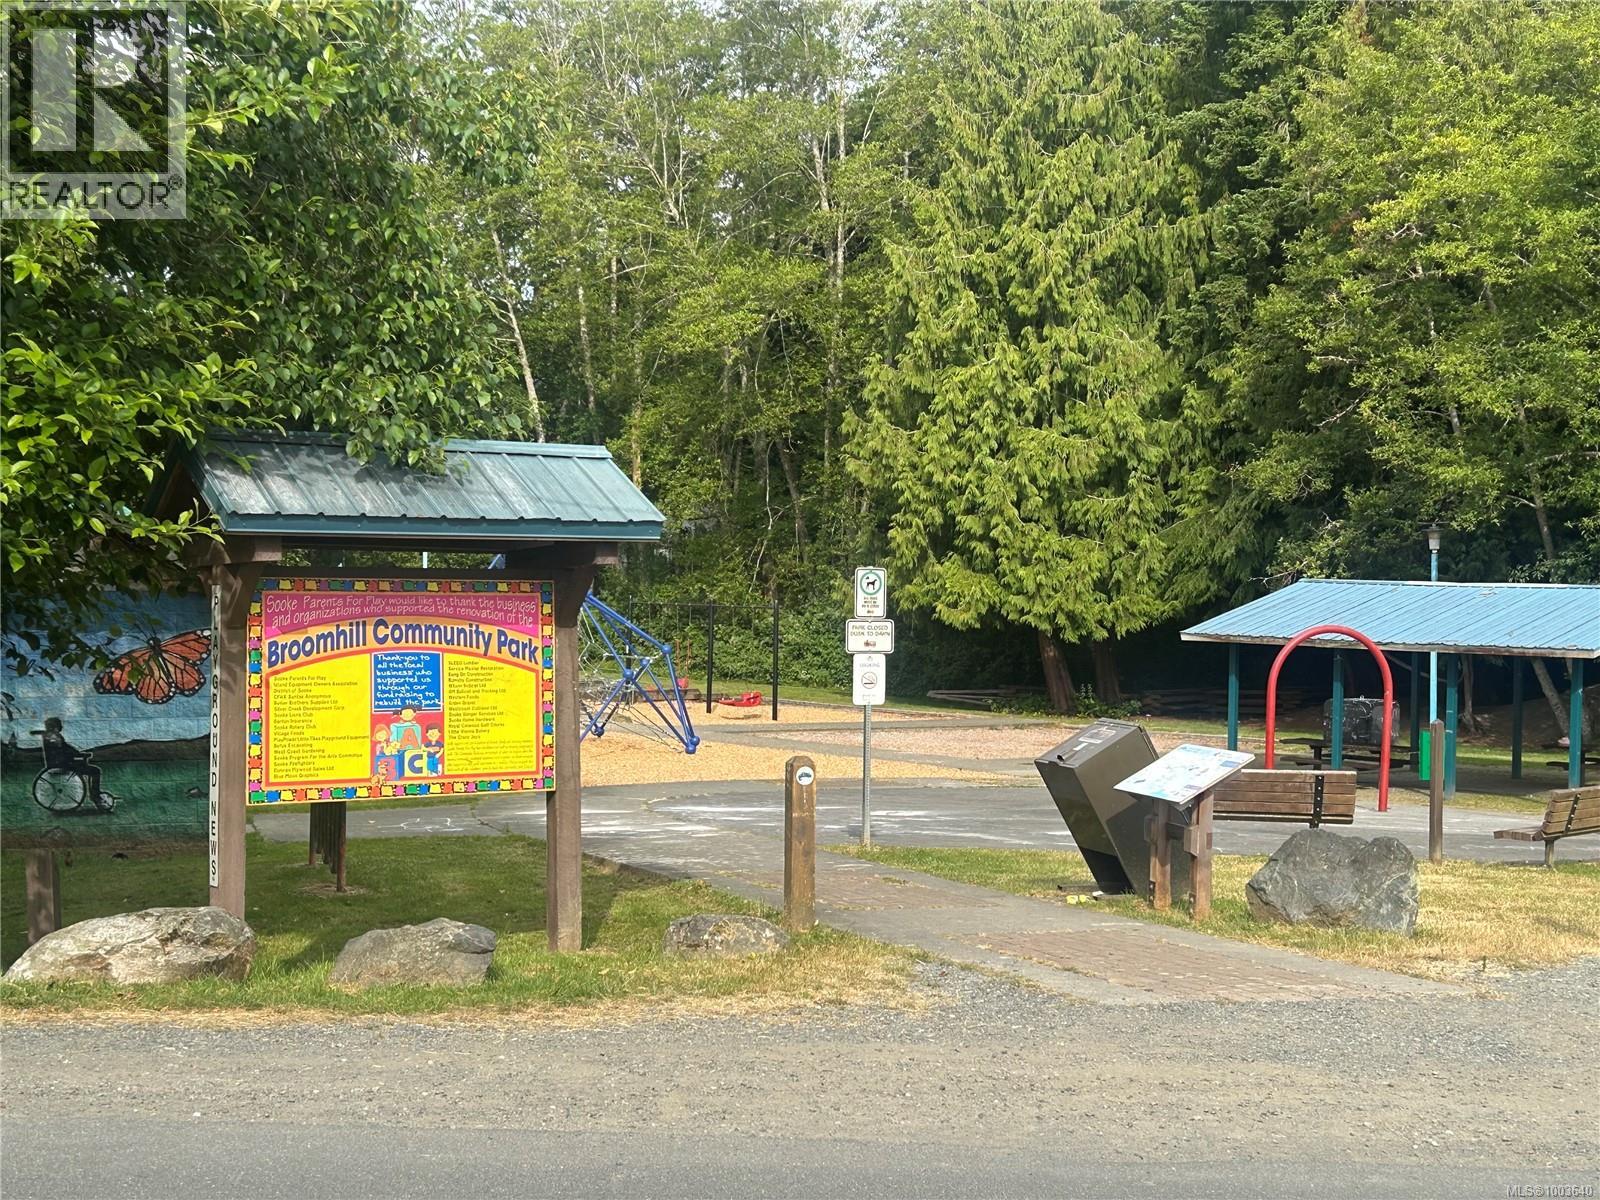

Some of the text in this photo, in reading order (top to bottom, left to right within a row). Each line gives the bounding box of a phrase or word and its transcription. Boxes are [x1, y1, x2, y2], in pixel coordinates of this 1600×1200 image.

[266, 595, 298, 612] Sooke
[304, 596, 344, 608] Parents
[346, 596, 362, 606] For
[366, 596, 388, 606] Play
[388, 596, 415, 605] would
[418, 596, 432, 605] like
[436, 597, 446, 606] to
[450, 596, 477, 606] thank
[479, 597, 491, 608] the
[272, 604, 532, 628] and organizations who supported the renovation of the
[268, 618, 538, 668] Broomhill Community Park
[377, 676, 418, 685] supported
[378, 684, 410, 692] through
[408, 754, 424, 774] C
